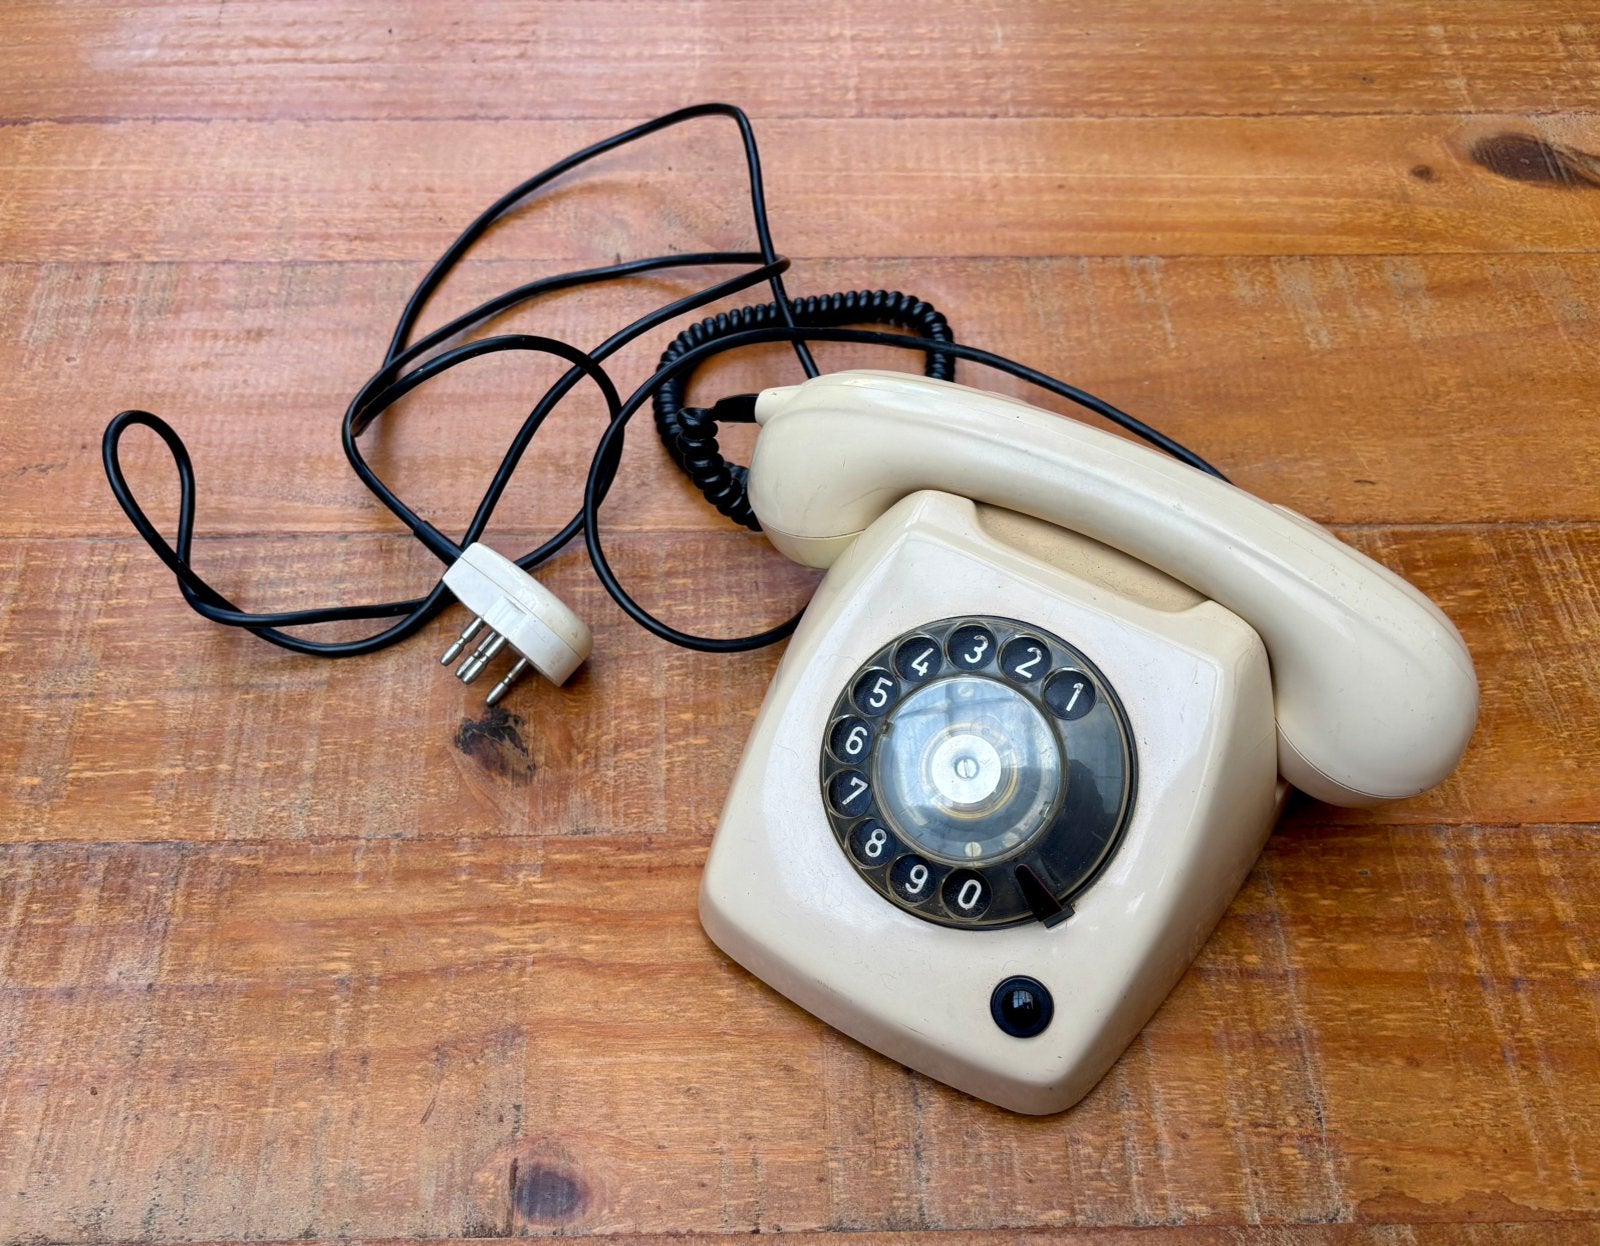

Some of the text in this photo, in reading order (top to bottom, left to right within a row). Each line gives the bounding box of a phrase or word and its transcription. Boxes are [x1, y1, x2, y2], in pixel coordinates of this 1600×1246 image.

[911, 647, 935, 677] 4
[964, 634, 988, 664] 3
[1014, 647, 1043, 678] 2
[869, 677, 893, 708] 5
[1065, 682, 1084, 711] 1
[845, 726, 868, 755] 6
[841, 777, 868, 805] 7
[864, 828, 887, 857] 8
[904, 864, 929, 894] 9
[957, 879, 982, 910] 0
